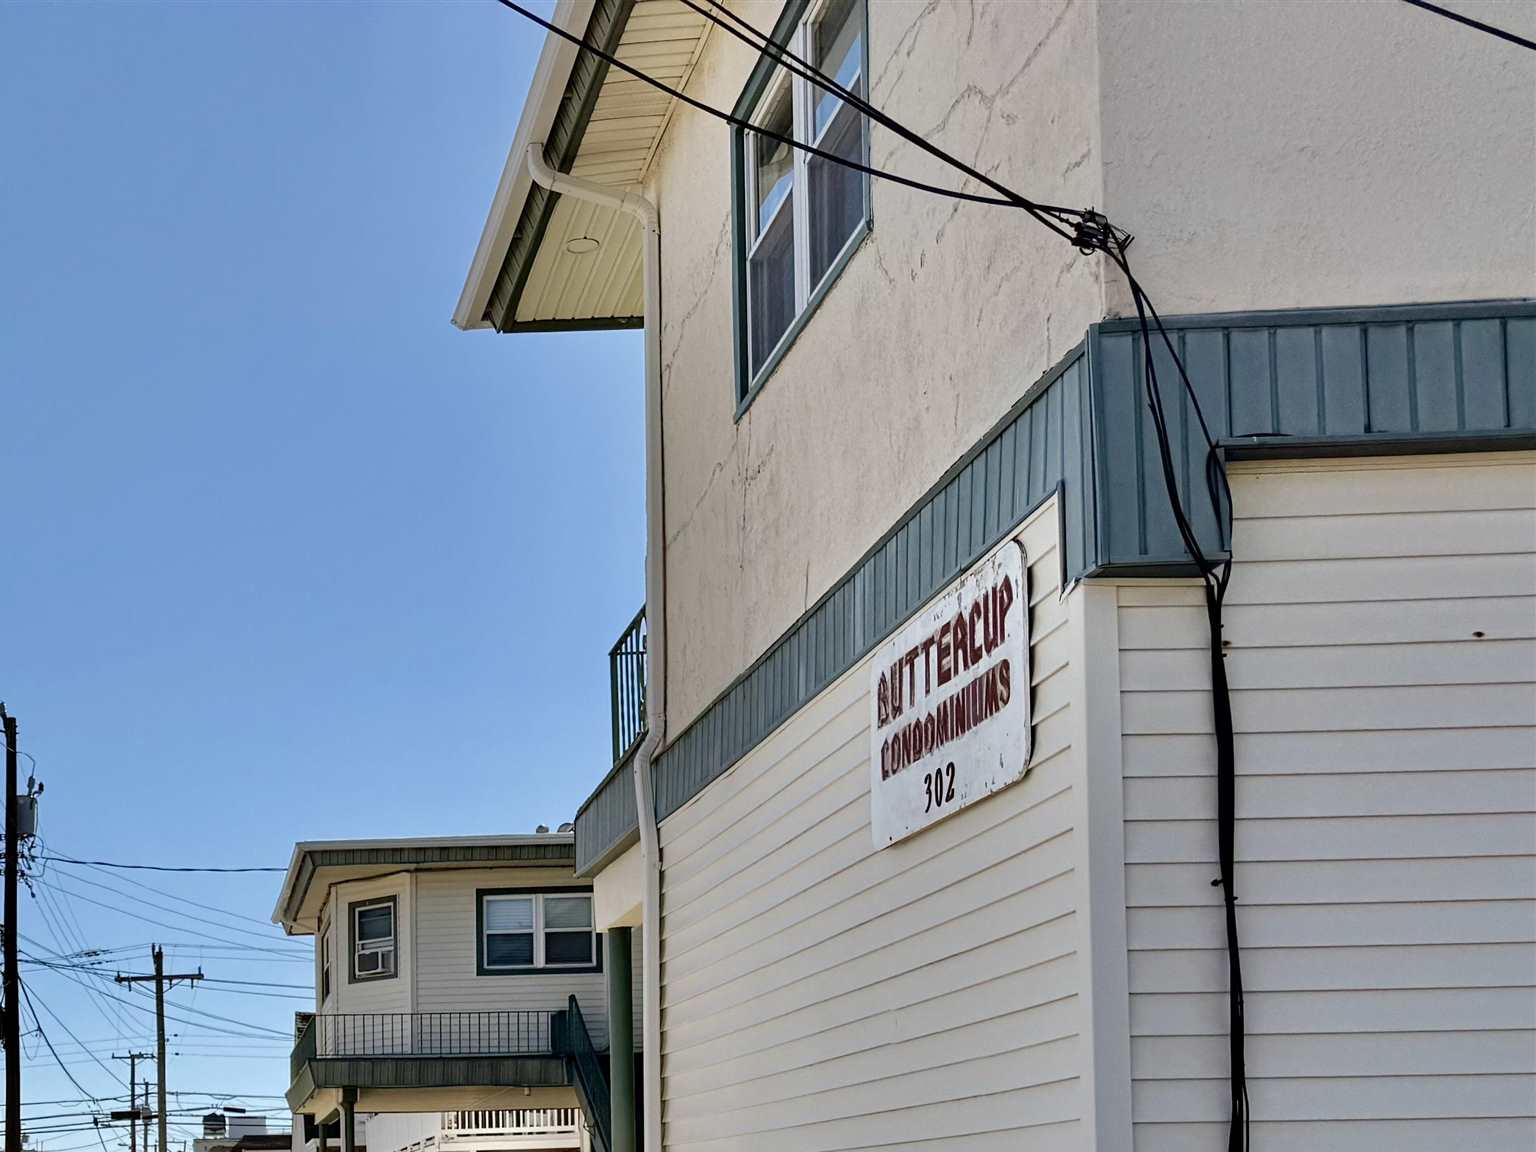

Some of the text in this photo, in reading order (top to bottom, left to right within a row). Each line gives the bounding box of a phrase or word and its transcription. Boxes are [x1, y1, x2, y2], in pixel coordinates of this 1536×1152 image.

[877, 574, 1014, 729] BUTTERCUP
[880, 658, 1011, 781] CONDOMINIUMS
[924, 761, 956, 814] 302
